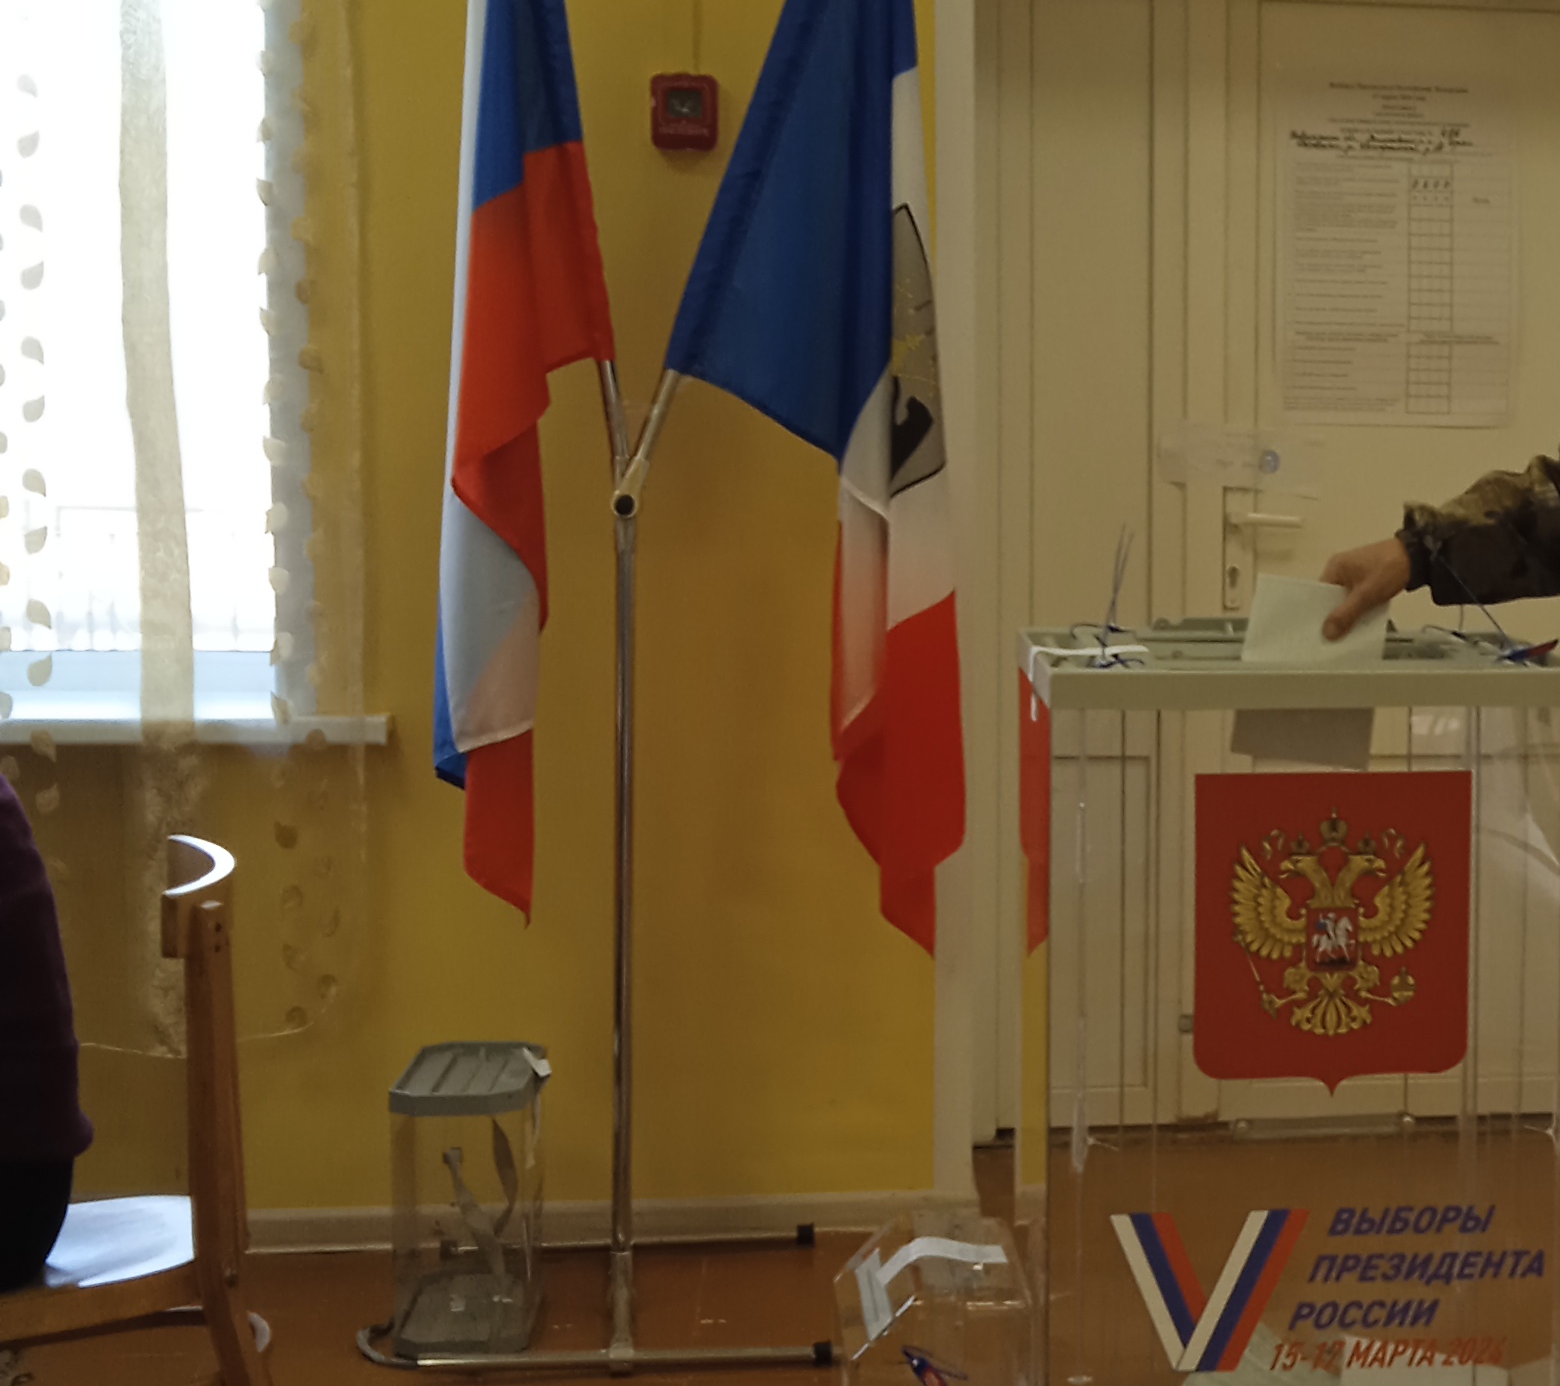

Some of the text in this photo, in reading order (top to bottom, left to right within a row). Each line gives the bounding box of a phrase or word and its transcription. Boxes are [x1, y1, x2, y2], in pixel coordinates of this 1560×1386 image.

[1328, 1204, 1496, 1237] ВЫБОРЫ
[1307, 1249, 1547, 1286] ПРЕЗИДЕНТА
[1287, 1297, 1440, 1331] РОССИИ
[1346, 1337, 1439, 1370] МАРТА
